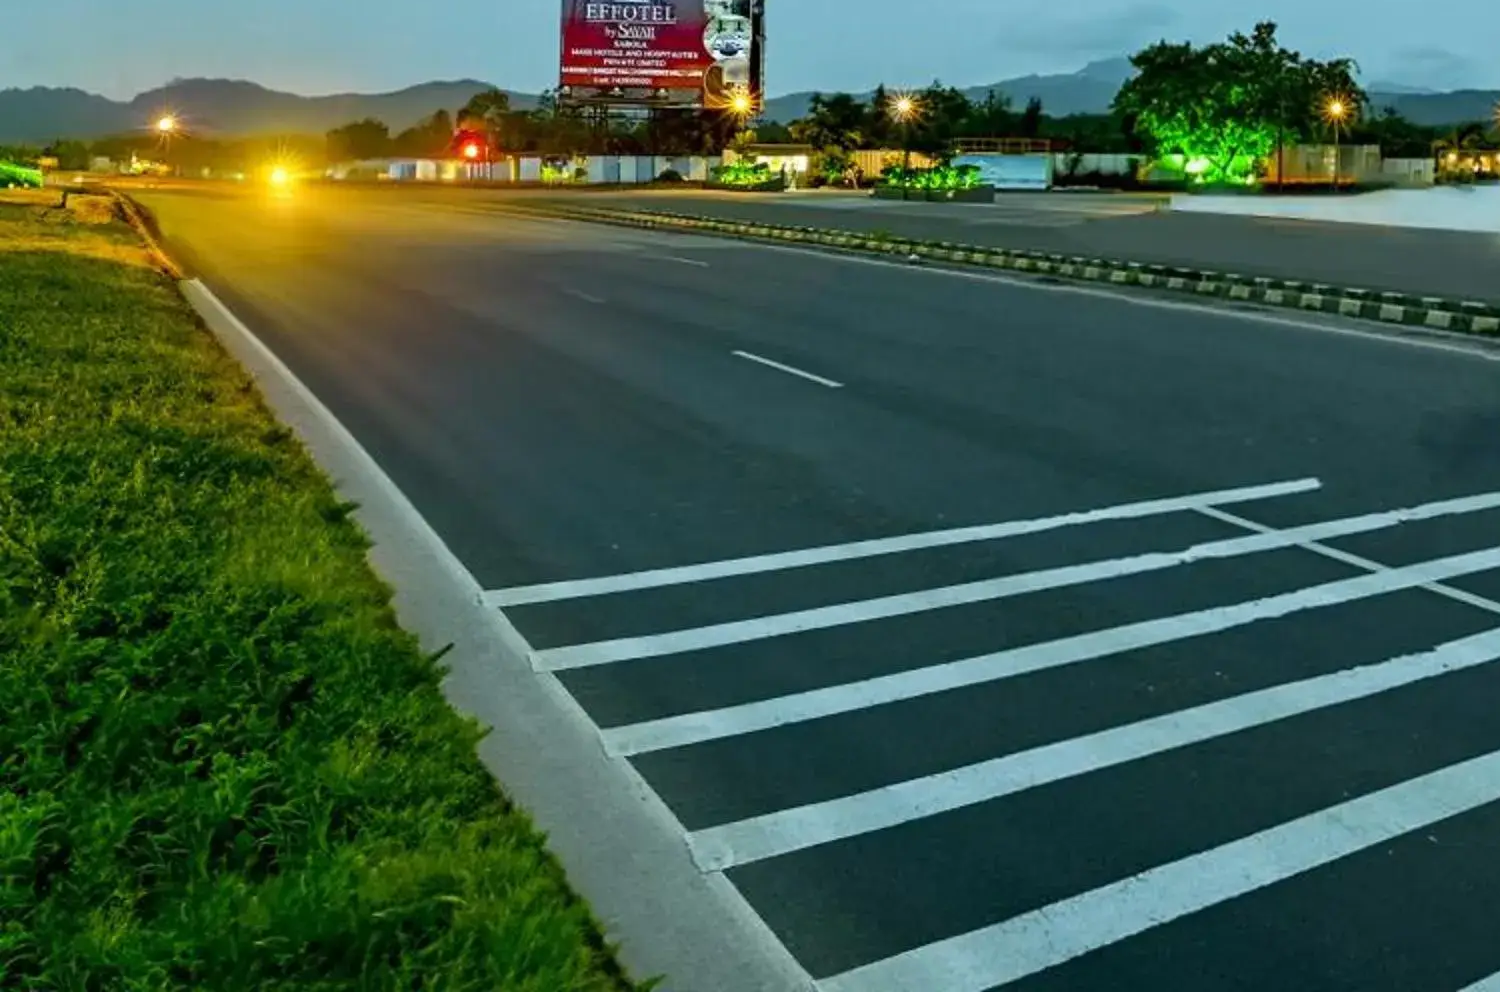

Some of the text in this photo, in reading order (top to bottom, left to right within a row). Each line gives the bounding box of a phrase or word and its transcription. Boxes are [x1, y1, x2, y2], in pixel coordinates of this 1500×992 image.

[586, 4, 676, 21] EFFOTEL
[605, 25, 616, 39] by
[594, 48, 623, 57] HOTELS
[626, 49, 642, 57] AND
